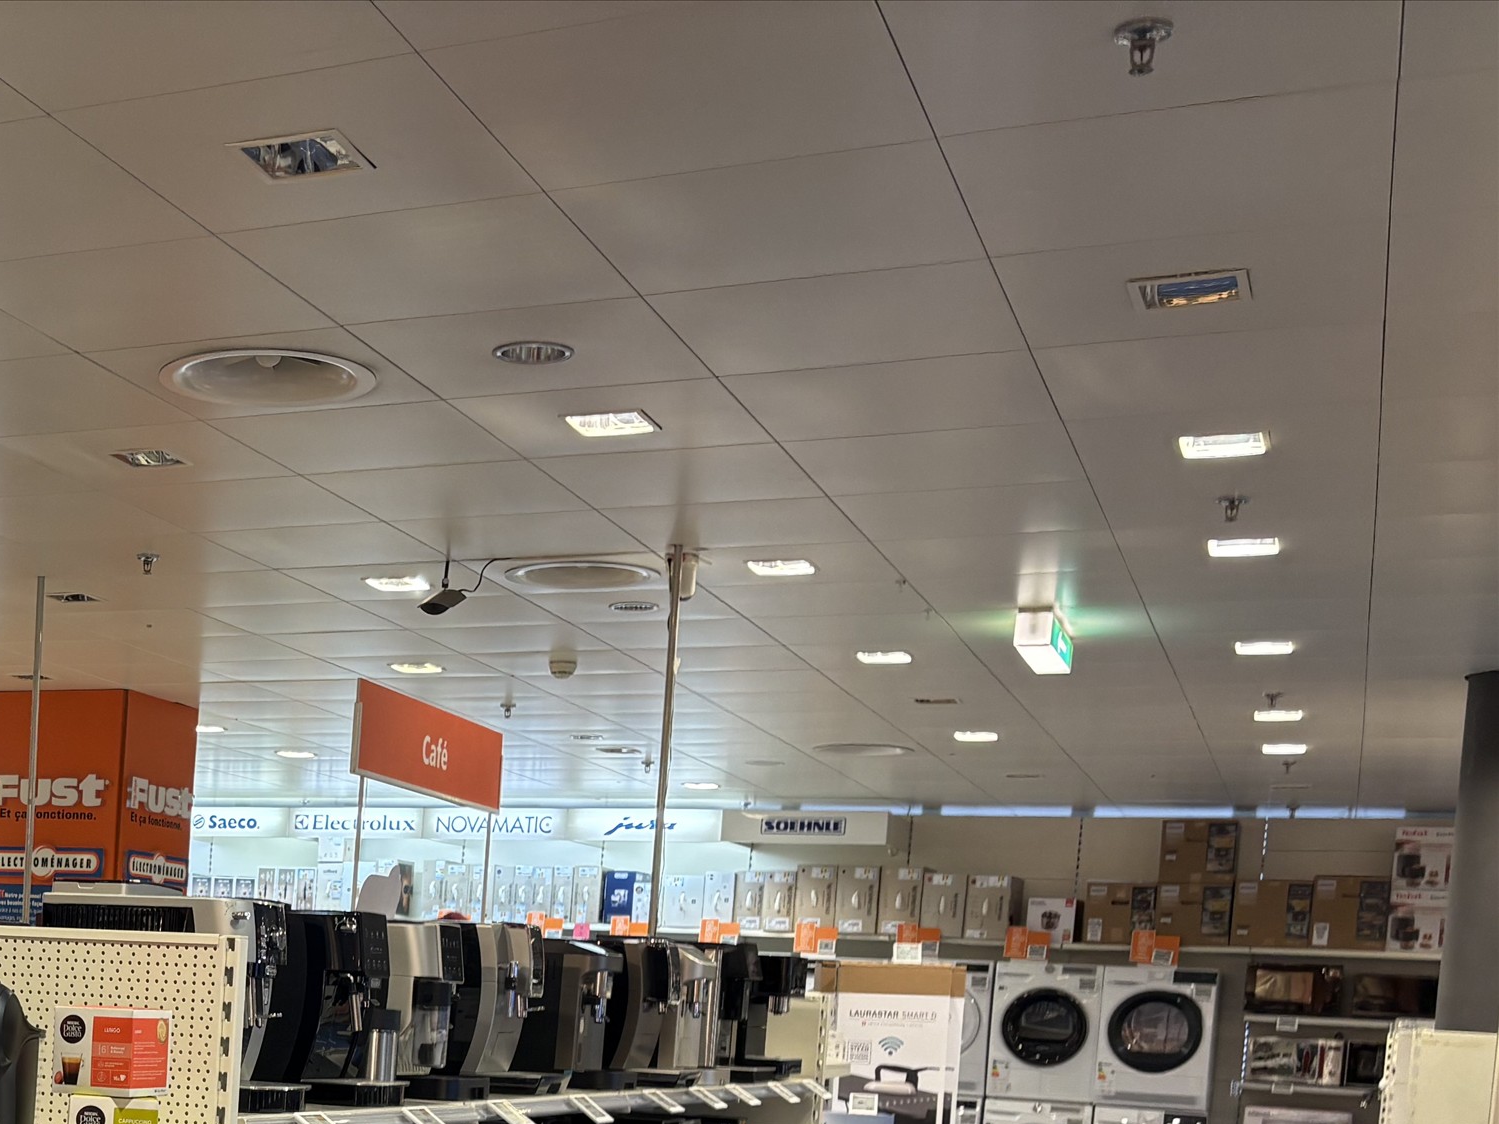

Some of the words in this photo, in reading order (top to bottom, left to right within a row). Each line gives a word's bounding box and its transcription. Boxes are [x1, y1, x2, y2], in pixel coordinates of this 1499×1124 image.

[422, 734, 449, 771] Café
[0, 808, 11, 819] Et
[15, 810, 26, 822] ça
[435, 816, 553, 834] NOVAMATIC
[132, 856, 185, 879] ÉLECTROMÉNAGER
[63, 1024, 82, 1032] Dolce
[80, 1114, 101, 1122] Dolce
